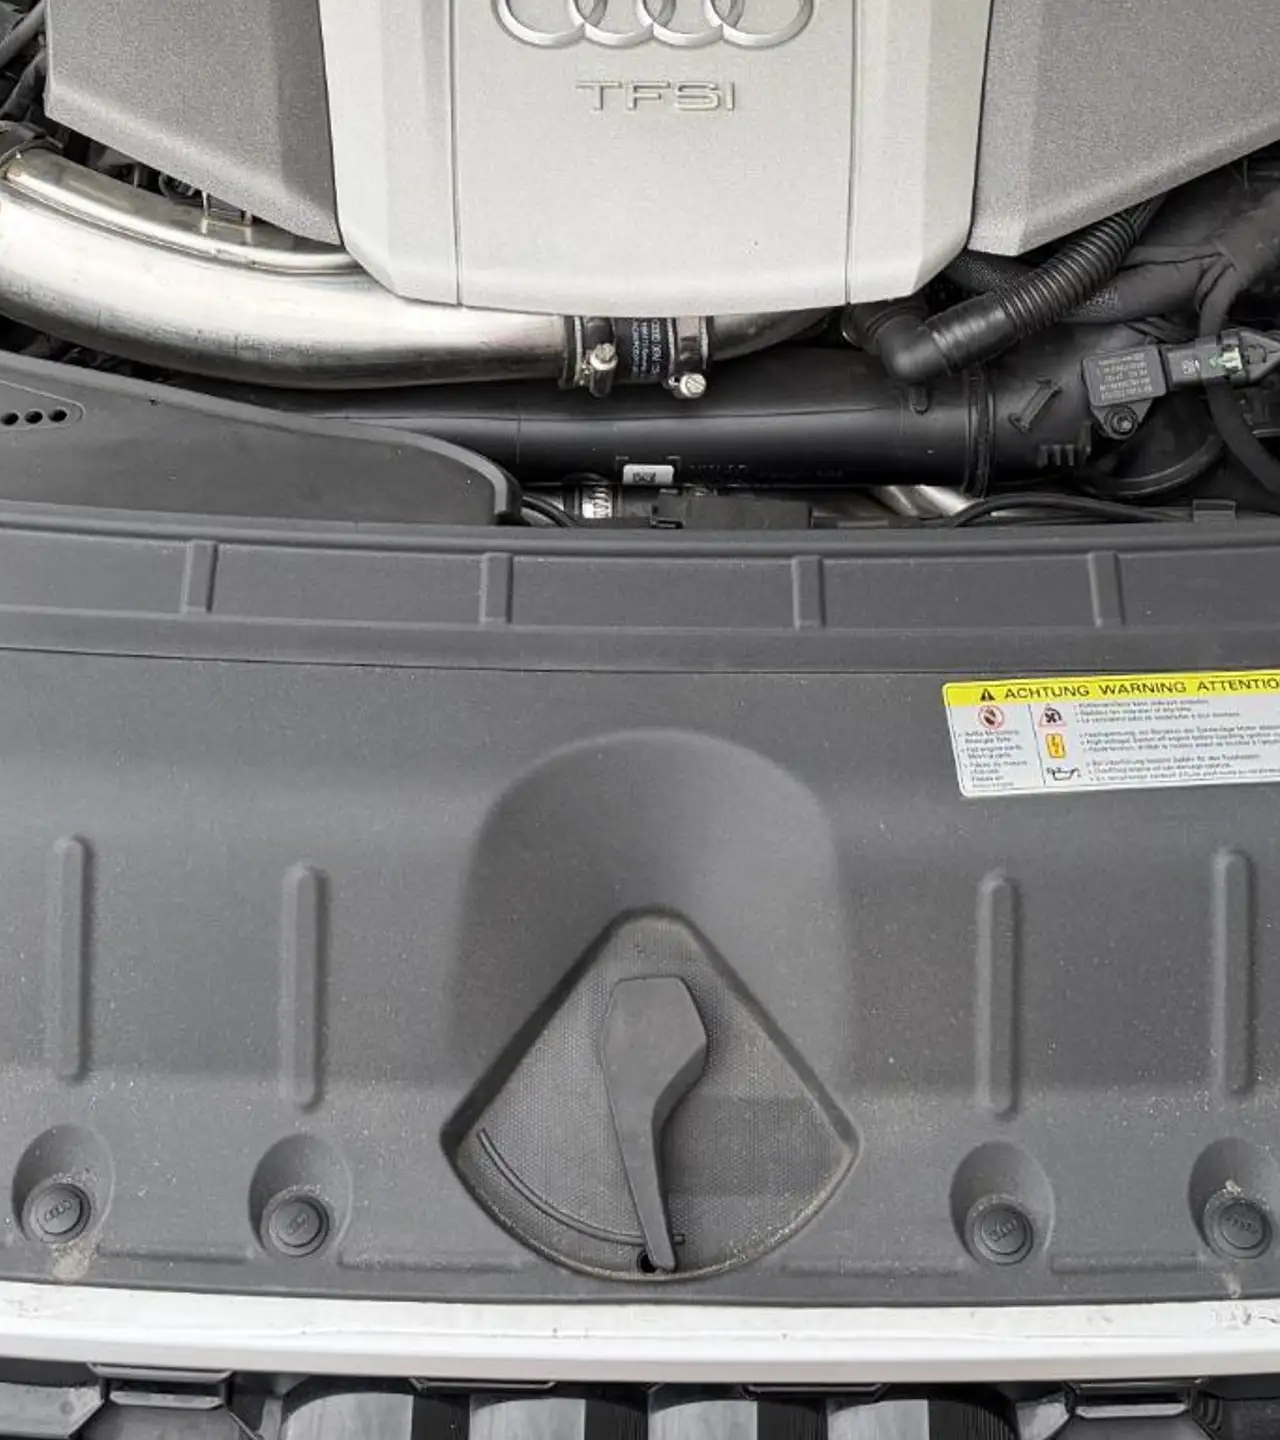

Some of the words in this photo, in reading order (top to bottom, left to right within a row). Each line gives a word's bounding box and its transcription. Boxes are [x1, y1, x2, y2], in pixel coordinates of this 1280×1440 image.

[575, 79, 736, 113] TFSI
[1004, 684, 1090, 700] ACHTUNG
[1098, 681, 1187, 696] WARNING
